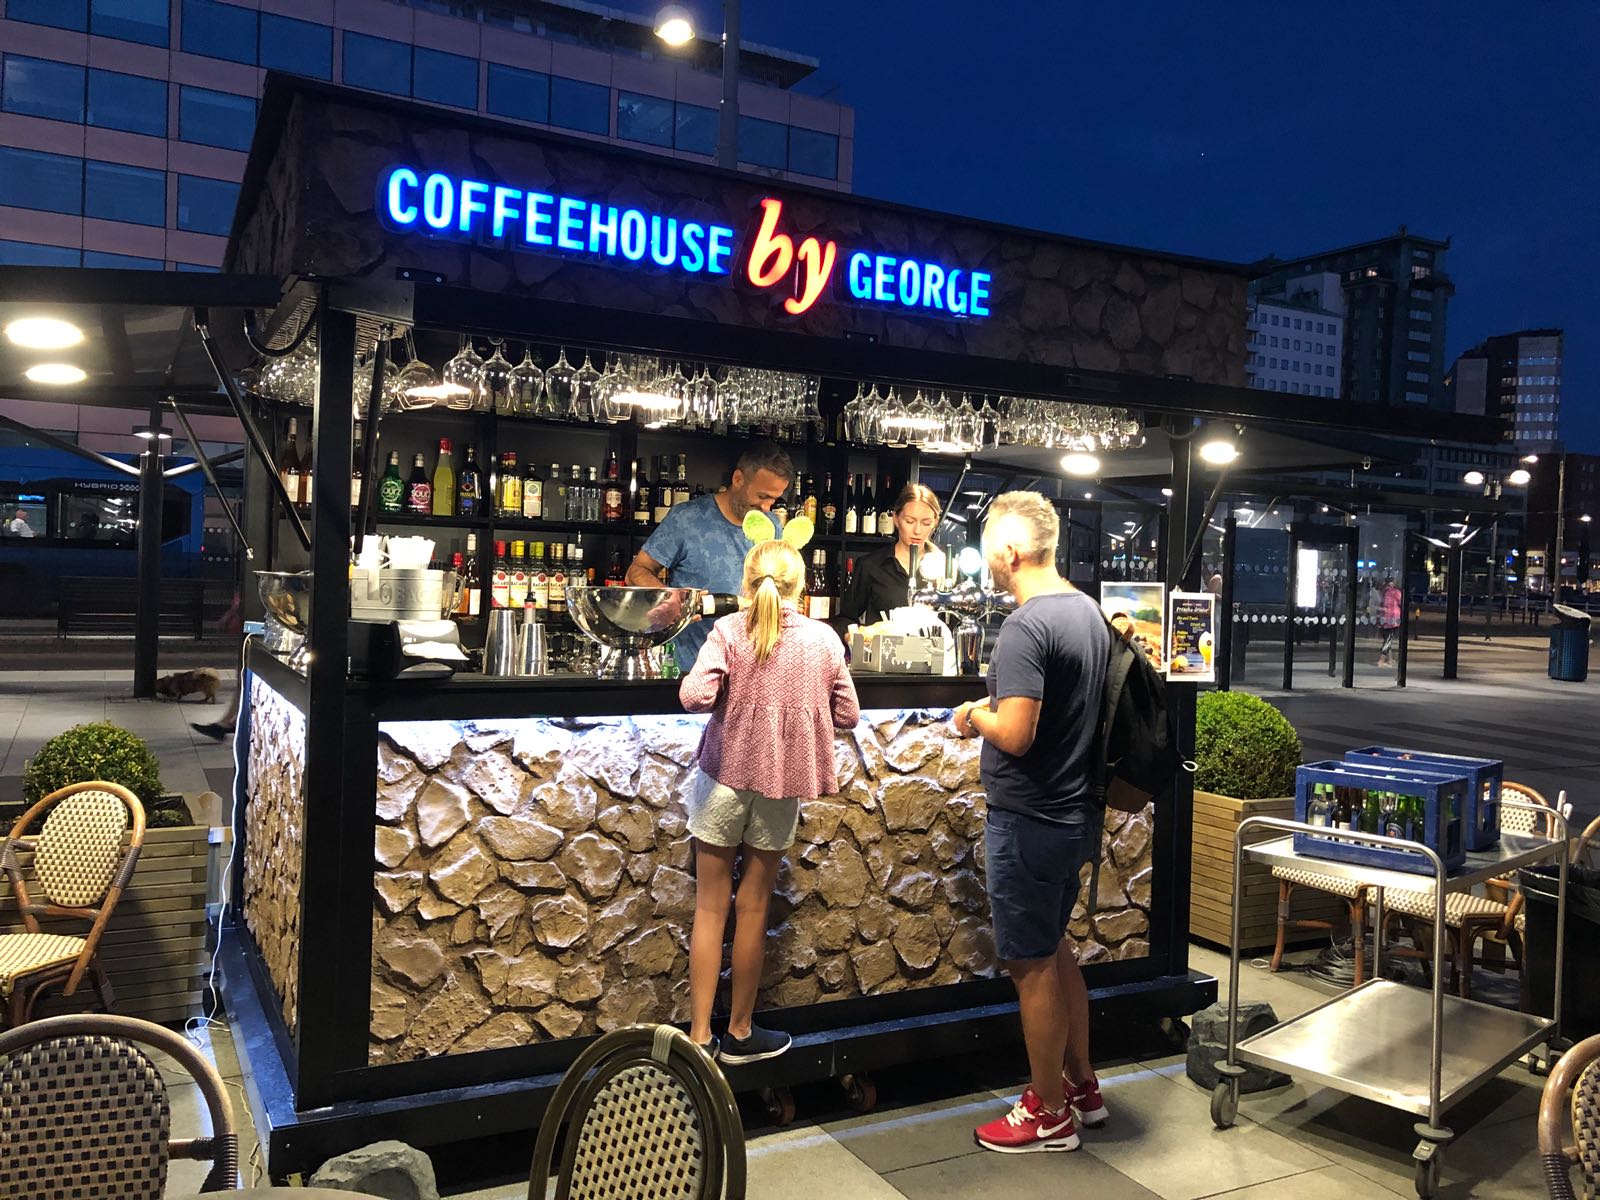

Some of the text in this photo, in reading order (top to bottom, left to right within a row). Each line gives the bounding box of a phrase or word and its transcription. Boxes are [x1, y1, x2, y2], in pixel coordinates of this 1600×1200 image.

[386, 167, 993, 318] COFFEEHOUSE by GEORGE
[74, 482, 119, 490] HYBRID
